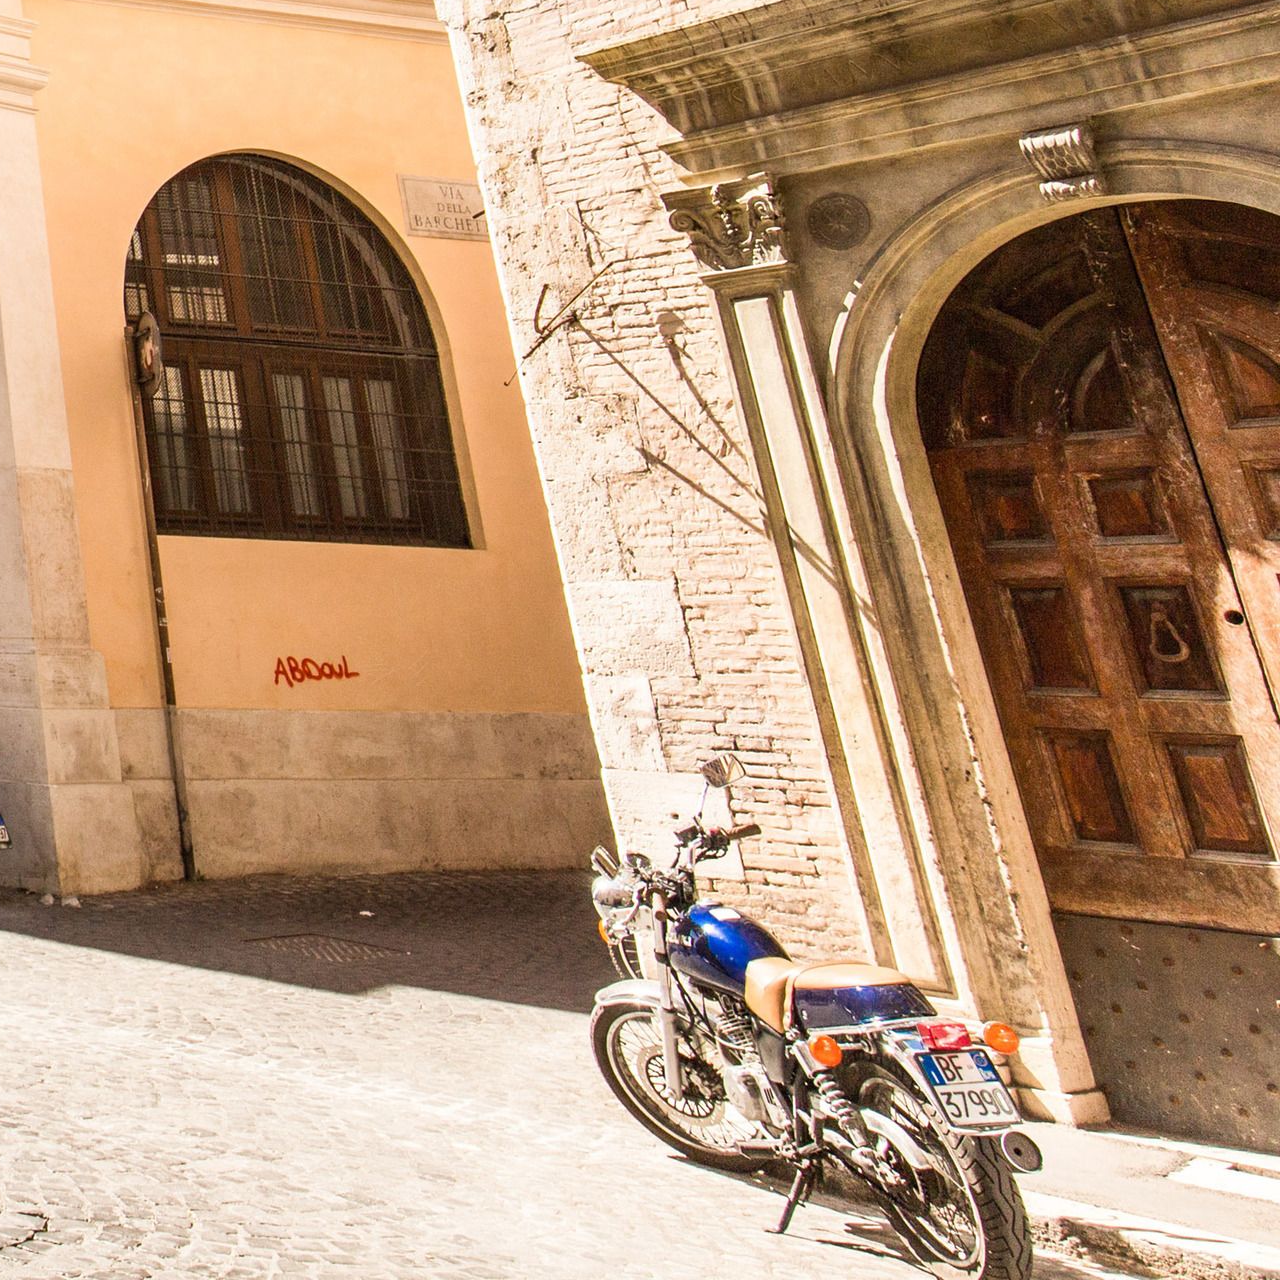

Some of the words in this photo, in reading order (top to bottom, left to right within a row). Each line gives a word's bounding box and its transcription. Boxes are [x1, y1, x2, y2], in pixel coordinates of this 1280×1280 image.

[439, 185, 464, 201] VIA
[437, 202, 472, 215] DELLA
[935, 1055, 963, 1082] BF
[940, 1087, 1013, 1119] 37990
